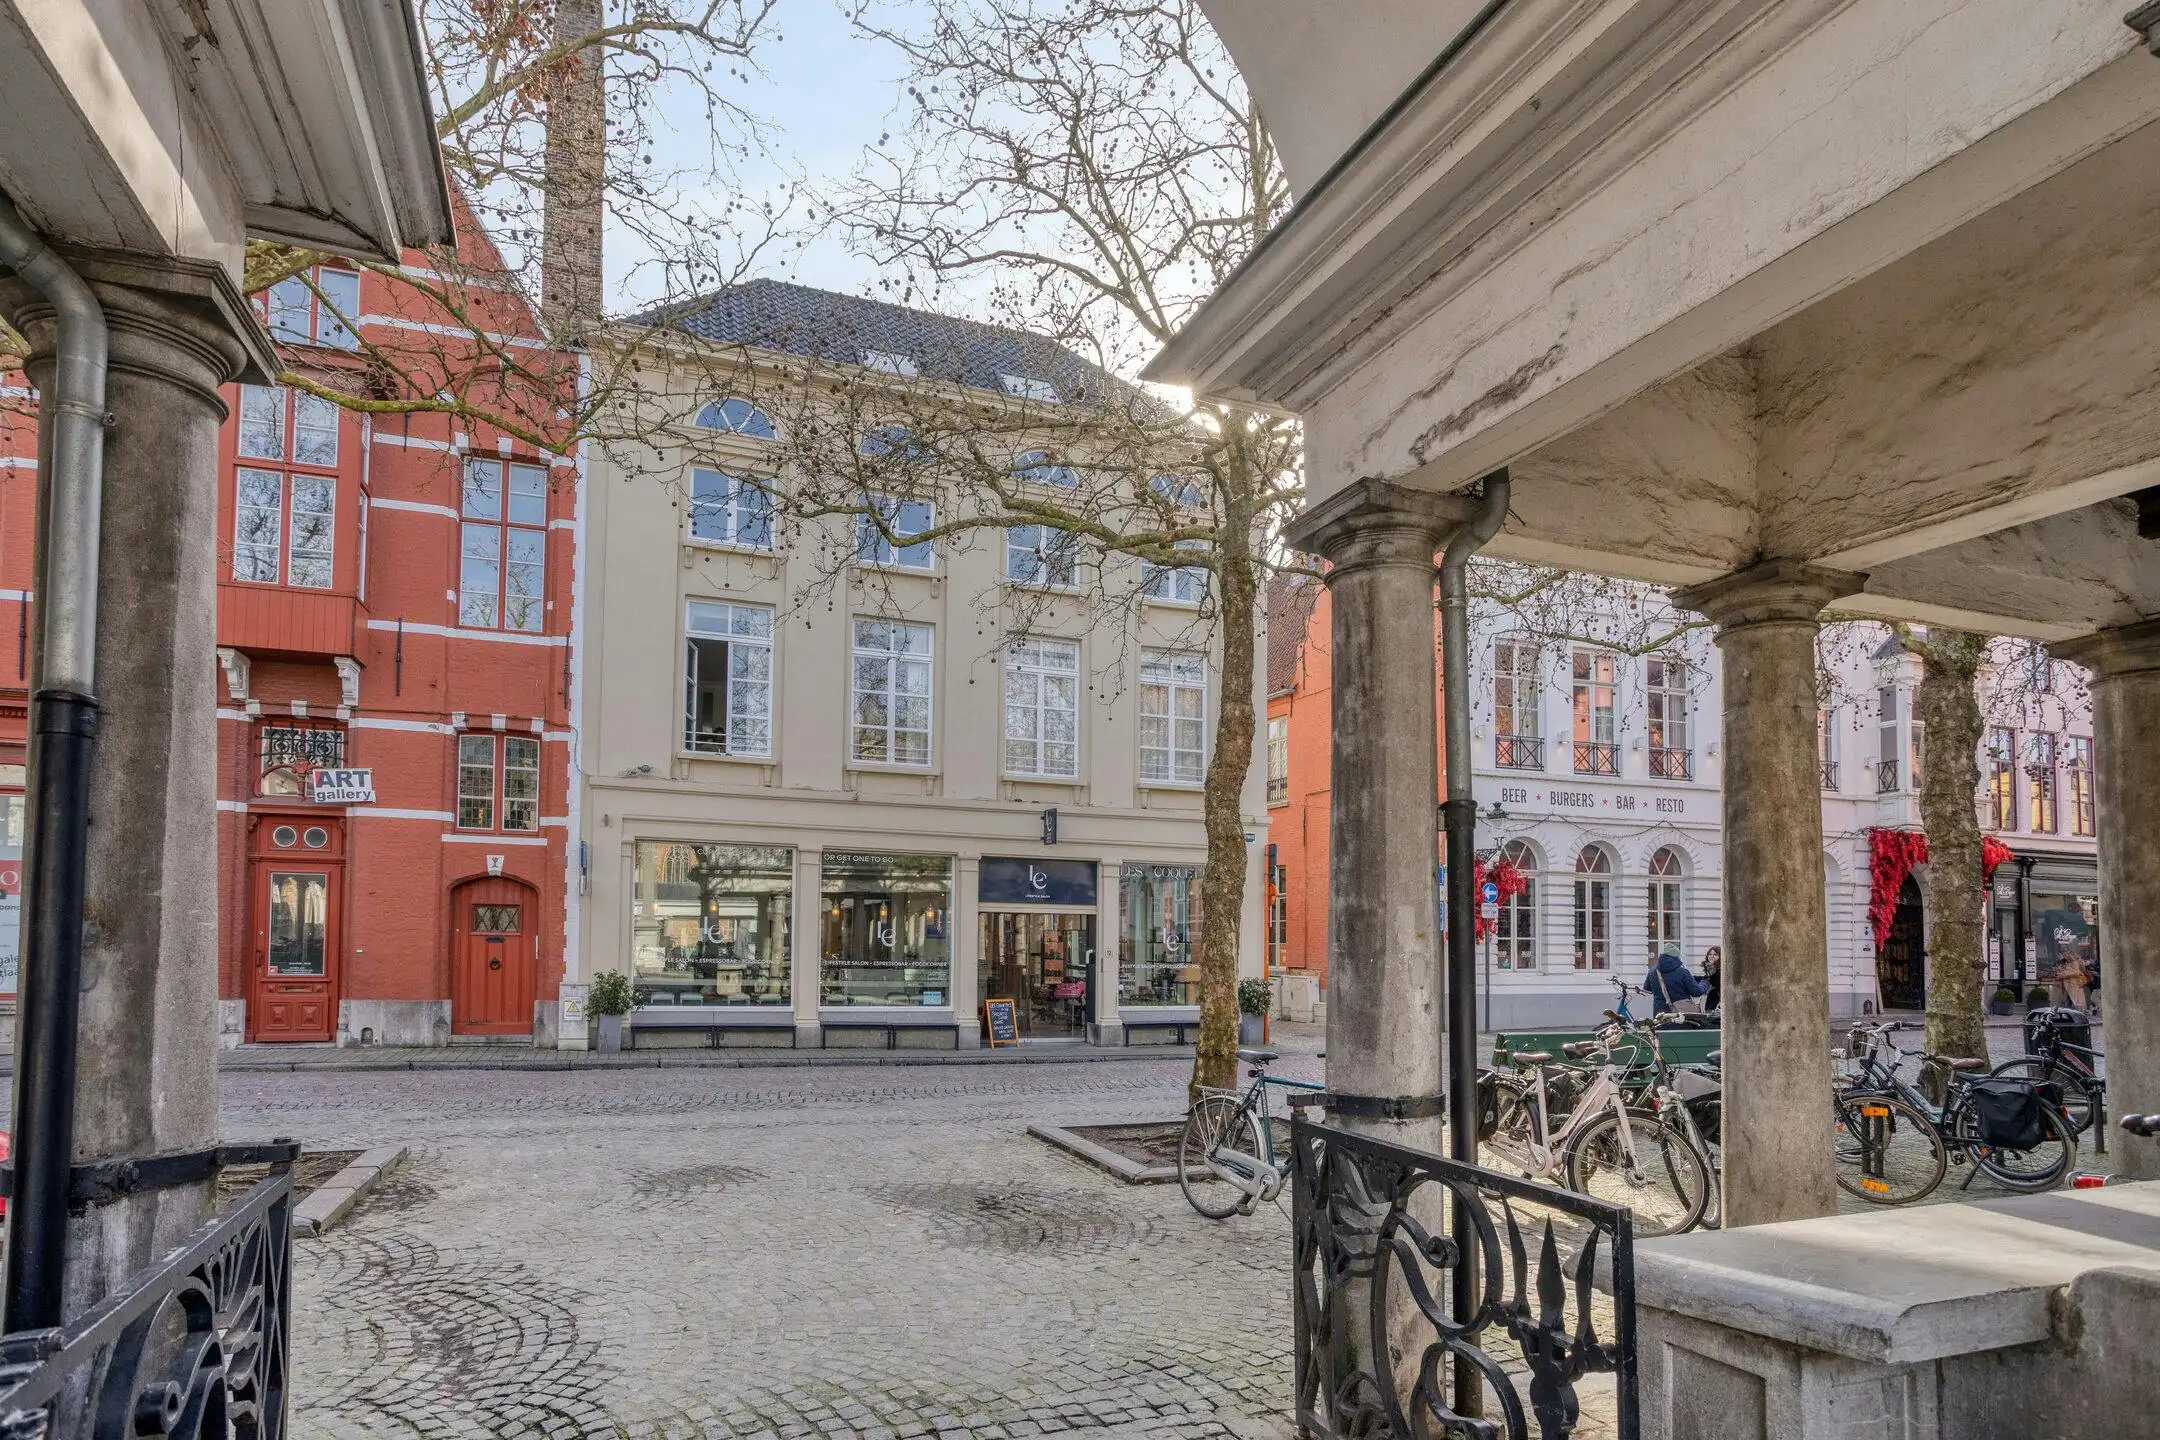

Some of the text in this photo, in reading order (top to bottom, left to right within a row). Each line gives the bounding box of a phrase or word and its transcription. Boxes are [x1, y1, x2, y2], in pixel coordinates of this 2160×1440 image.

[315, 770, 370, 788] ART
[316, 788, 371, 802] gallery
[1502, 788, 1684, 813] BEER BURGERS BAR RESTO
[823, 853, 835, 861] OR
[837, 854, 851, 862] GET
[870, 855, 881, 863] TO
